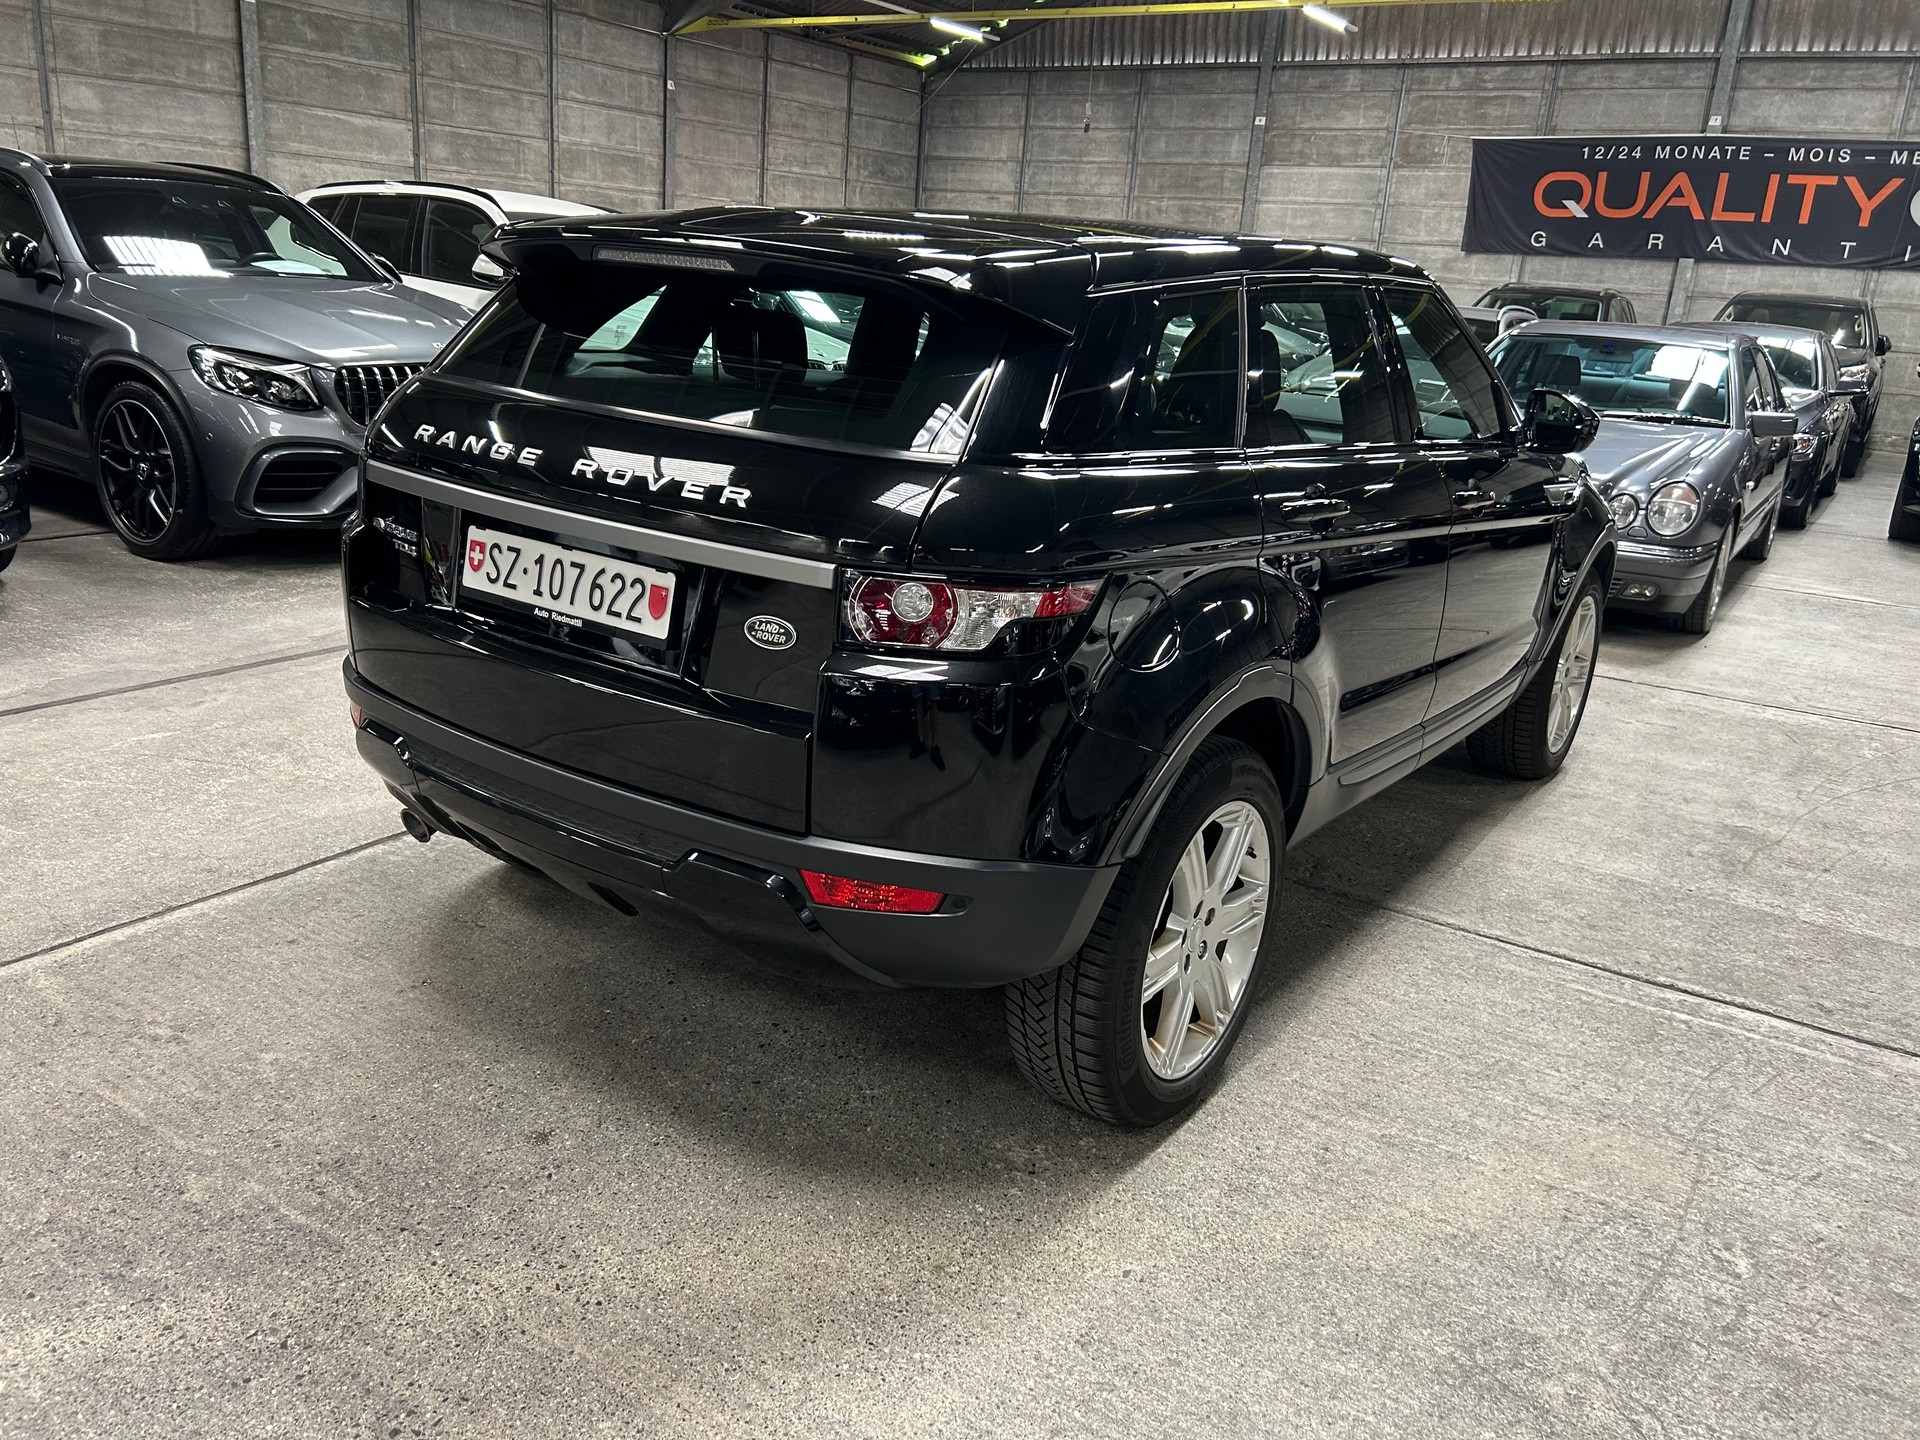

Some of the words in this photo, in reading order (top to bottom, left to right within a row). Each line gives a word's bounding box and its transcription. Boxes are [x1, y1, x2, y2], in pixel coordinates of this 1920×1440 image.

[1582, 145, 1641, 159] 12/24
[1655, 145, 1751, 160] MONATE
[1788, 147, 1851, 162] MOIS
[1533, 171, 1906, 228] QUALITY
[413, 424, 543, 466] RANGE
[572, 458, 752, 508] ROVER
[533, 607, 549, 618] Auto
[1117, 957, 1139, 1071] Continental
